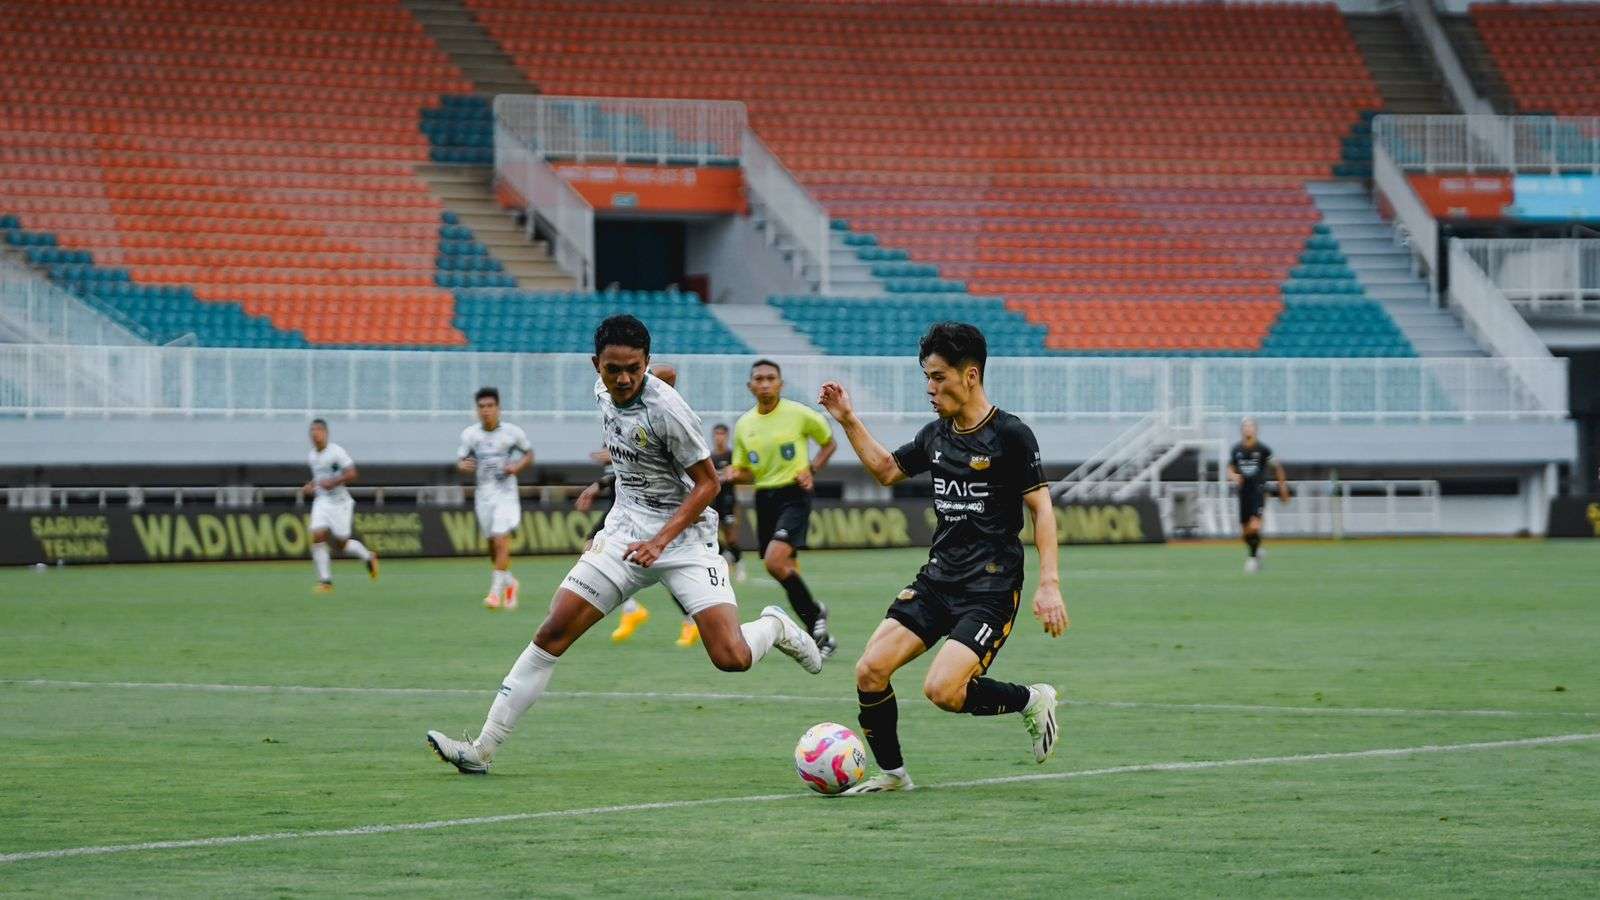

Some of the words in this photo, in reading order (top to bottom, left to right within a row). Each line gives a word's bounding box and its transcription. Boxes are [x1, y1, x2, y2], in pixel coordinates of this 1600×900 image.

[934, 478, 989, 497] BAIC
[441, 510, 604, 554] WIMO
[747, 507, 911, 550] DIMOR
[974, 622, 993, 646] 11
